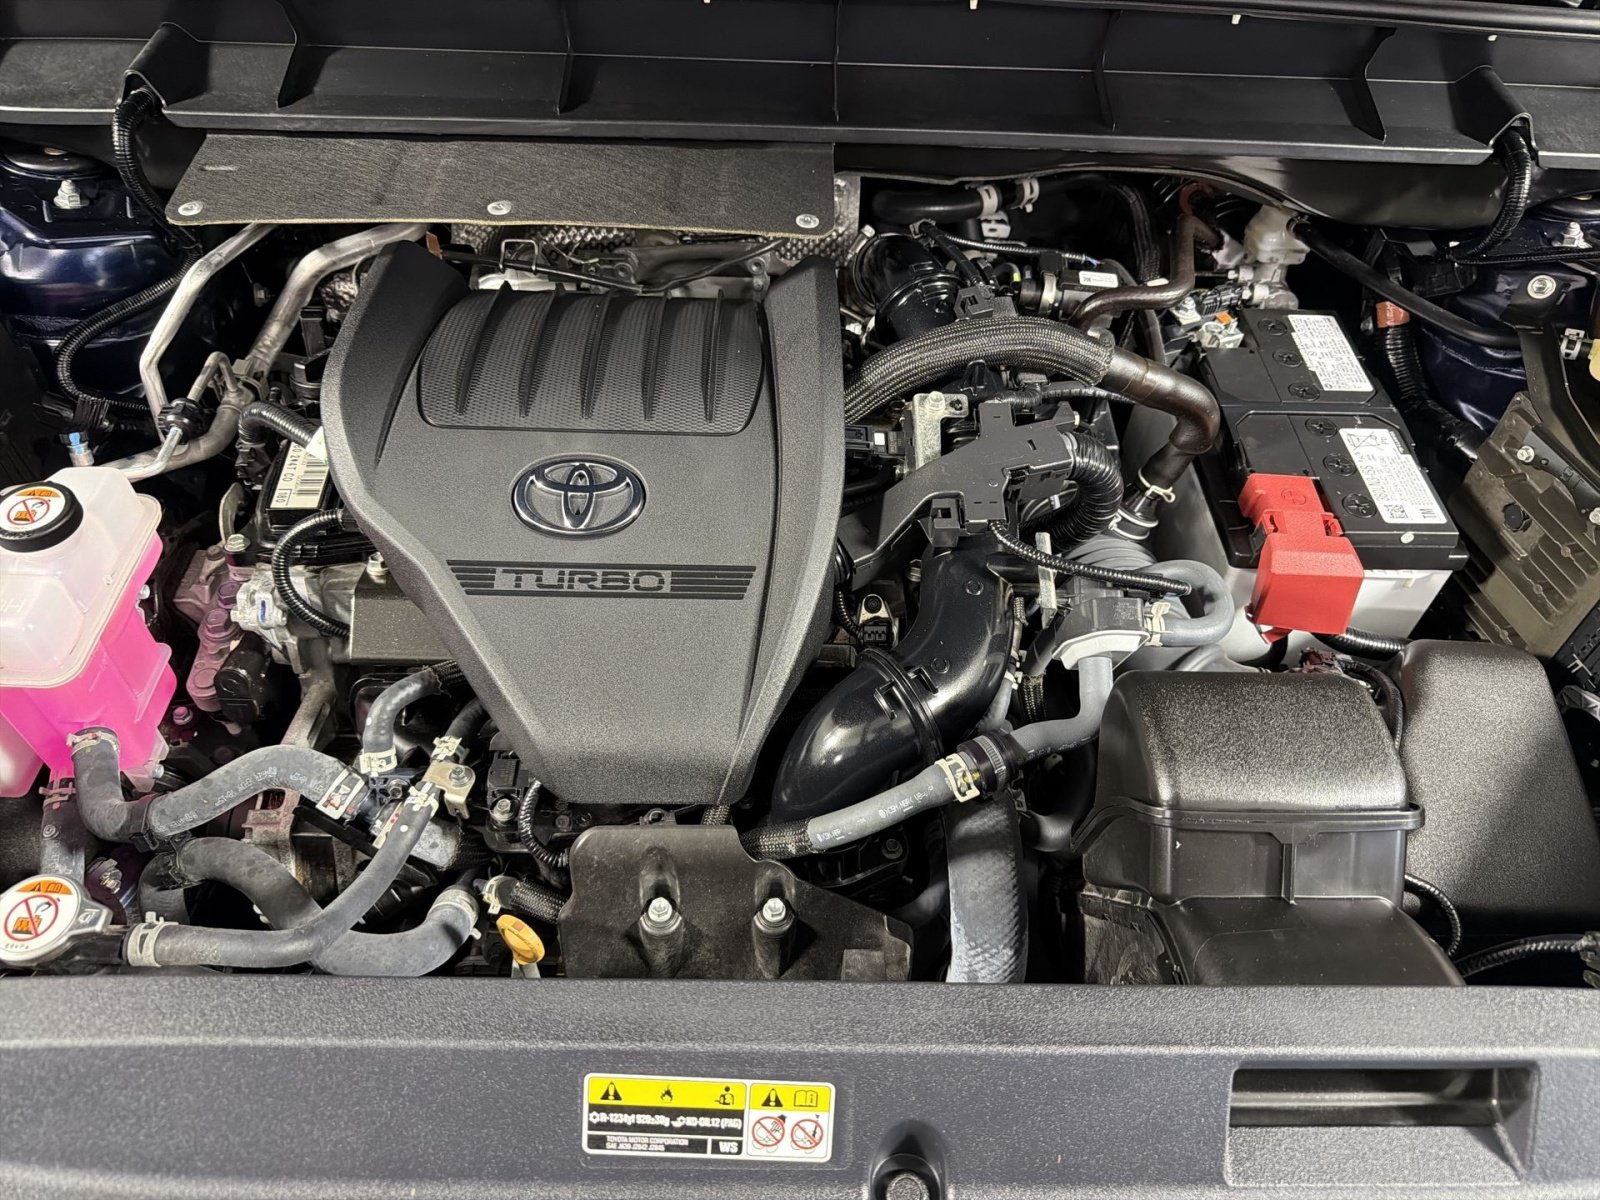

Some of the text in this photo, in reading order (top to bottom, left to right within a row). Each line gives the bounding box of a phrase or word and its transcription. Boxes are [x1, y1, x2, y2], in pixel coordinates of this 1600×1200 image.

[500, 568, 667, 592] TURBO
[606, 1135, 689, 1146] TOYOTA MOTOR CORPORATION
[718, 1140, 739, 1154] WS
